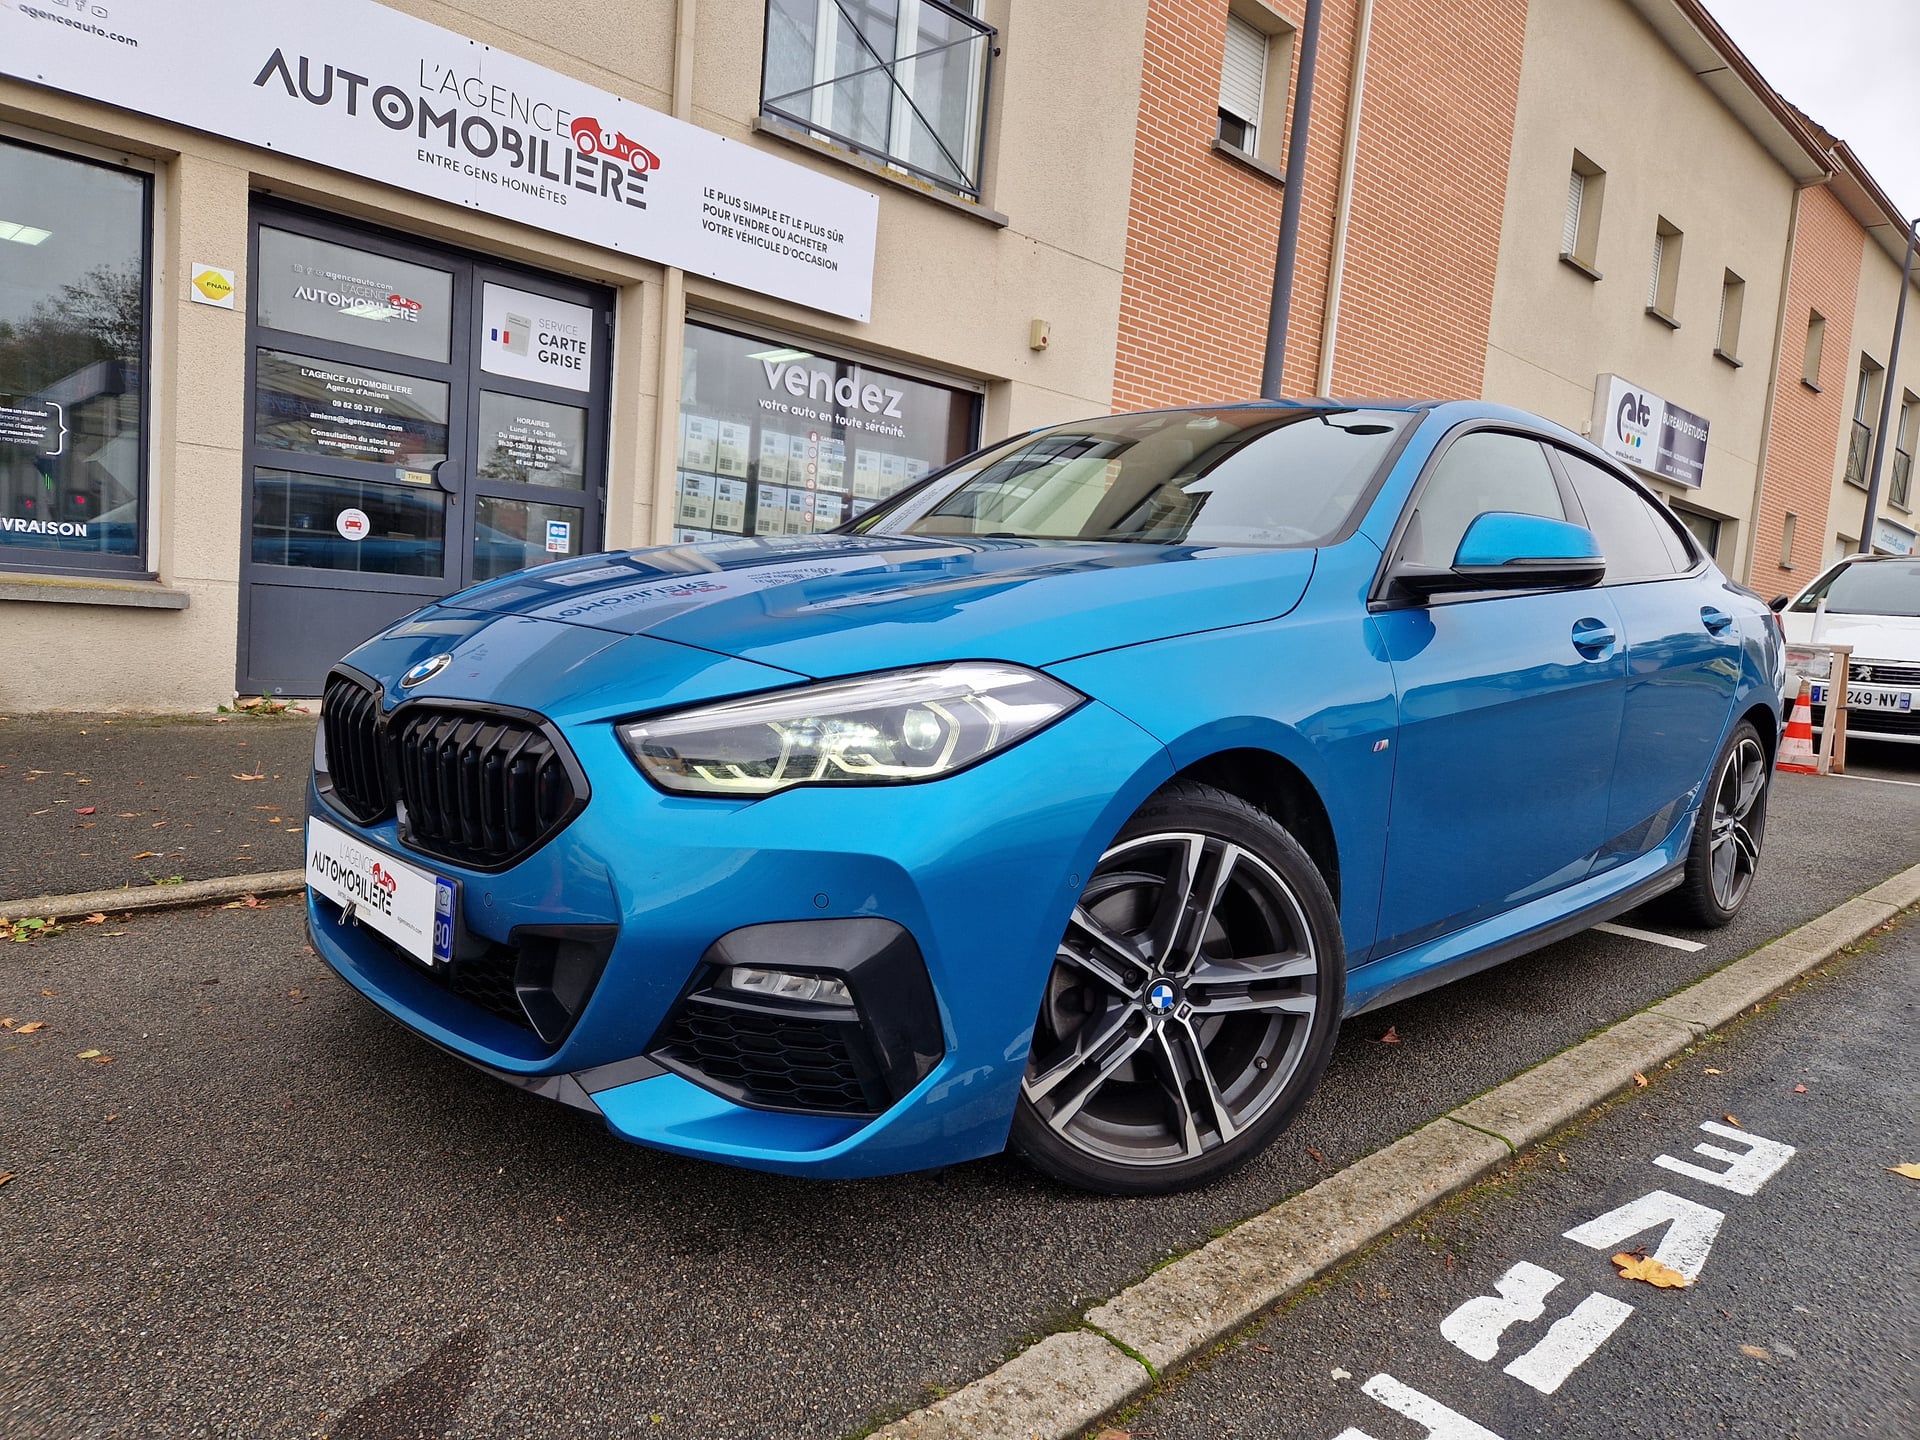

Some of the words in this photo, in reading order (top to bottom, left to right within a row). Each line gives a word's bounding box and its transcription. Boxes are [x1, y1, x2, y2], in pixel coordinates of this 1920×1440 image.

[19, 4, 138, 47] agenceauto.com
[419, 58, 572, 139] L'AGENCE
[417, 149, 461, 174] ENTRE
[464, 164, 498, 186] GENS
[501, 175, 568, 206] HONNÊTES
[703, 186, 715, 199] LE
[717, 191, 741, 208] PLUS
[743, 200, 777, 221] SIMPLE
[779, 213, 791, 226] ET
[791, 217, 802, 229] LE
[804, 221, 825, 238] PLUS
[827, 227, 844, 243] SÛR
[703, 203, 731, 221] POUR
[732, 211, 770, 234] VENDRE
[772, 226, 786, 239] OU
[787, 232, 828, 253] ACHETER
[702, 218, 734, 238] VOTRE
[735, 228, 781, 253] VÉHICULE
[782, 245, 838, 271] D'OCCASION
[325, 270, 393, 291] agenceauto.com
[538, 317, 578, 336] SERVICE
[538, 332, 587, 355] CARTE
[538, 349, 582, 371] GRISE
[301, 368, 345, 383] L'AGENCE
[346, 376, 413, 395] AUTOMOBILIERE
[326, 382, 354, 396] Agence
[356, 386, 390, 400] d'Amiens
[762, 359, 904, 419] vendez
[332, 400, 342, 408] 09
[309, 411, 403, 432] amiens@agenceauto.com
[509, 425, 528, 434] Lundi
[516, 416, 550, 428] HORAIRES
[759, 399, 788, 414] votre
[791, 404, 816, 419] auto
[819, 411, 832, 423] en
[835, 413, 862, 430] toute
[865, 419, 906, 438] sérénité.
[1661, 411, 1683, 431] BUREAU
[1683, 421, 1708, 442] D'ETUDES
[310, 428, 357, 442] Consultation
[358, 434, 368, 444] du
[368, 436, 388, 447] stock
[389, 440, 401, 448] sur
[318, 438, 395, 456] www.agenceauto.com
[434, 920, 449, 949] 80
